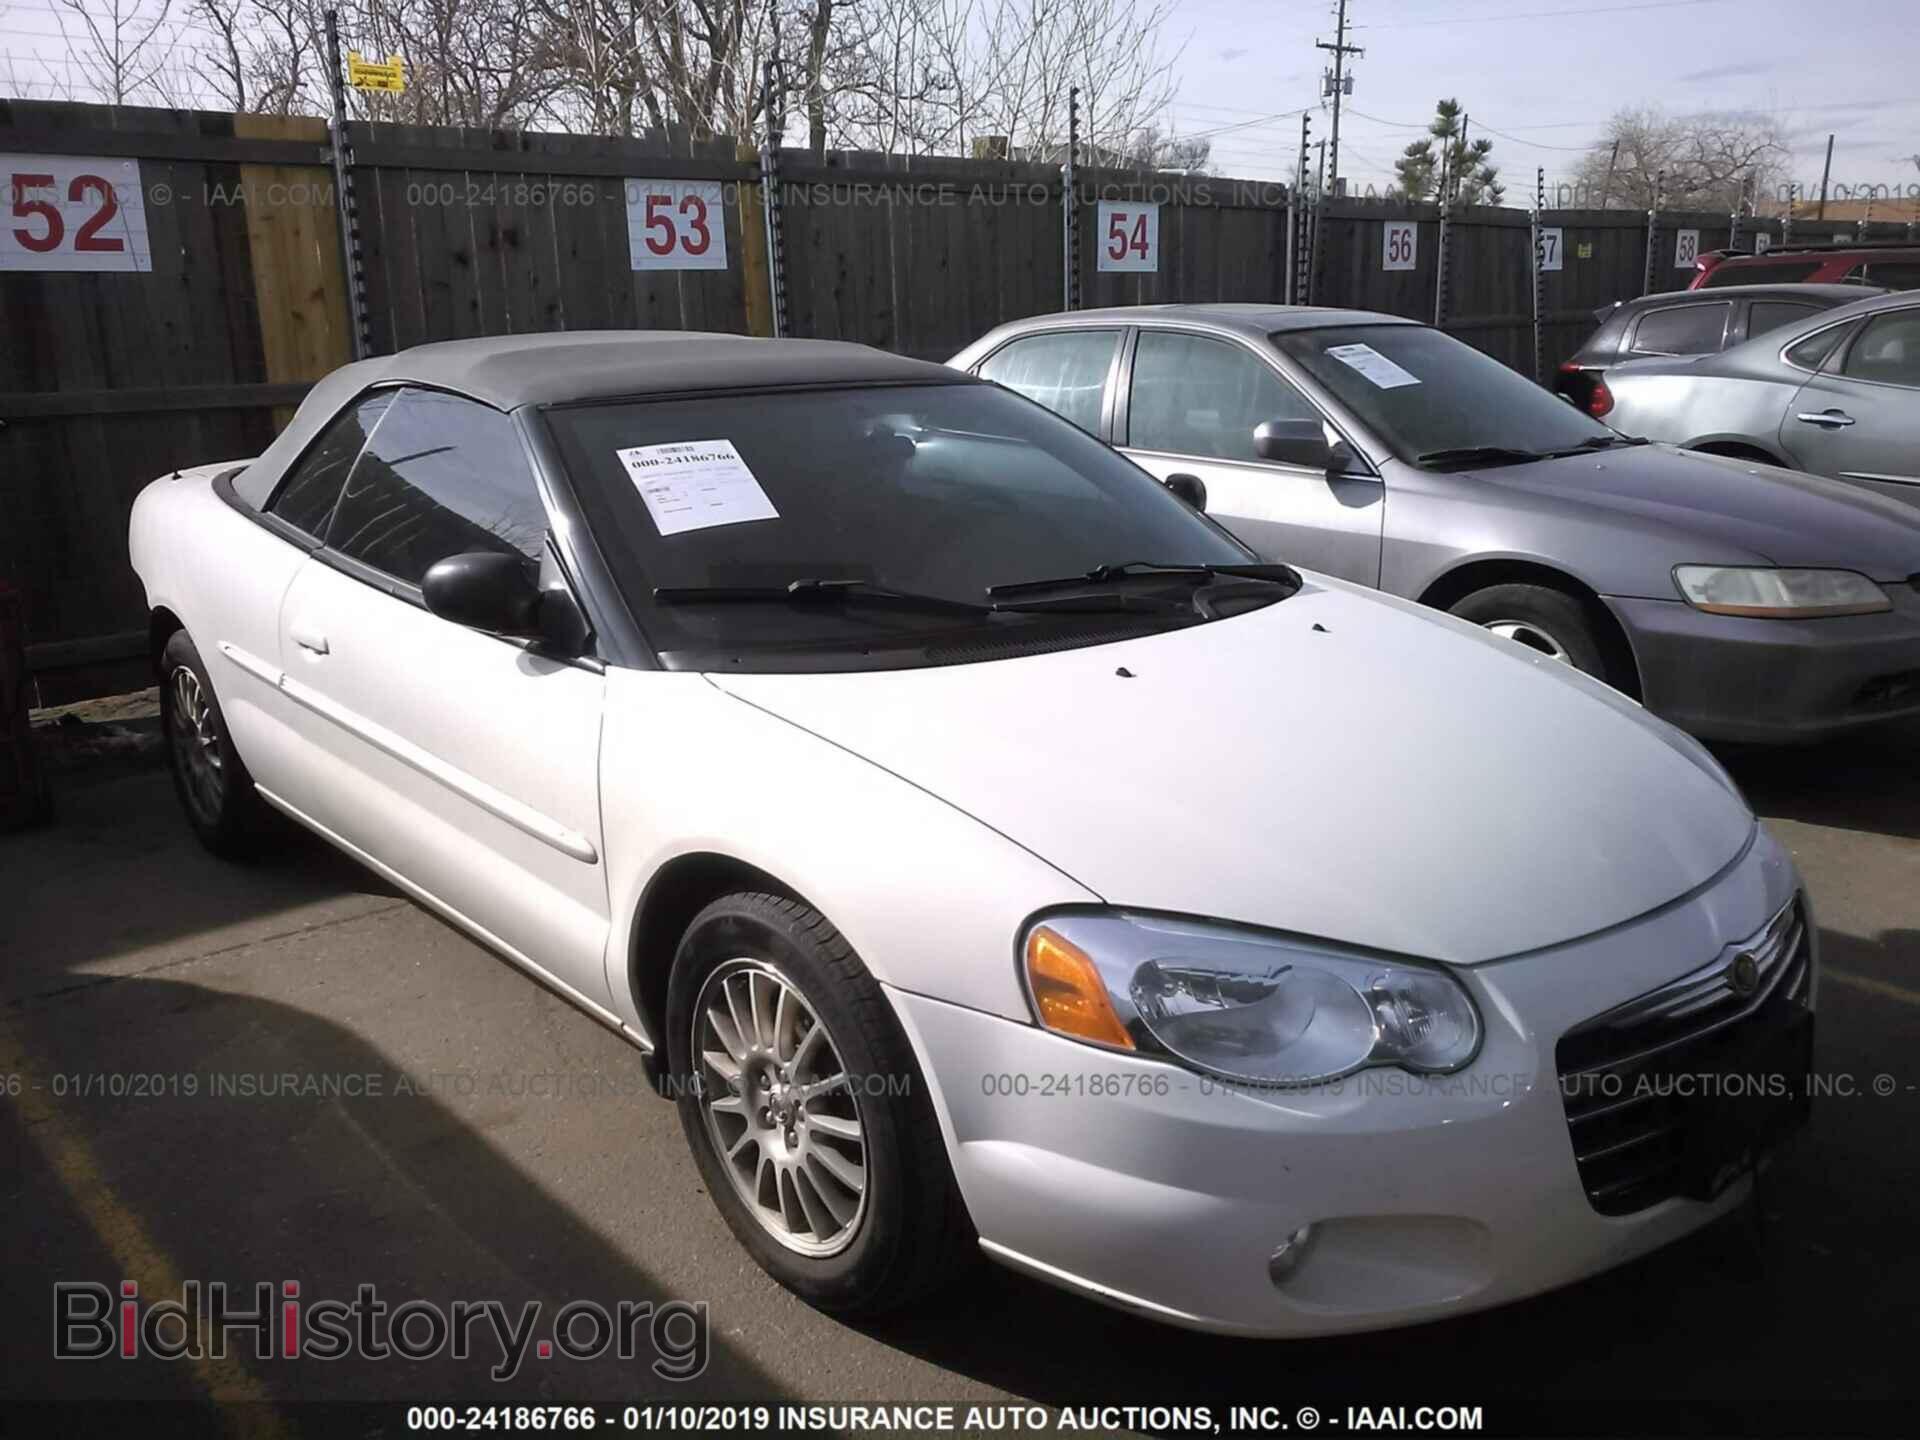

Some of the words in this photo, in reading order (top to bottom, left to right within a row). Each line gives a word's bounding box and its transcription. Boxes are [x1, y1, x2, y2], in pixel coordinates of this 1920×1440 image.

[12, 173, 124, 252] 52
[645, 195, 711, 256] 53
[1108, 213, 1149, 261] 54
[1389, 229, 1412, 262] 56
[1679, 235, 1695, 262] 58
[631, 453, 735, 469] 000-24186766
